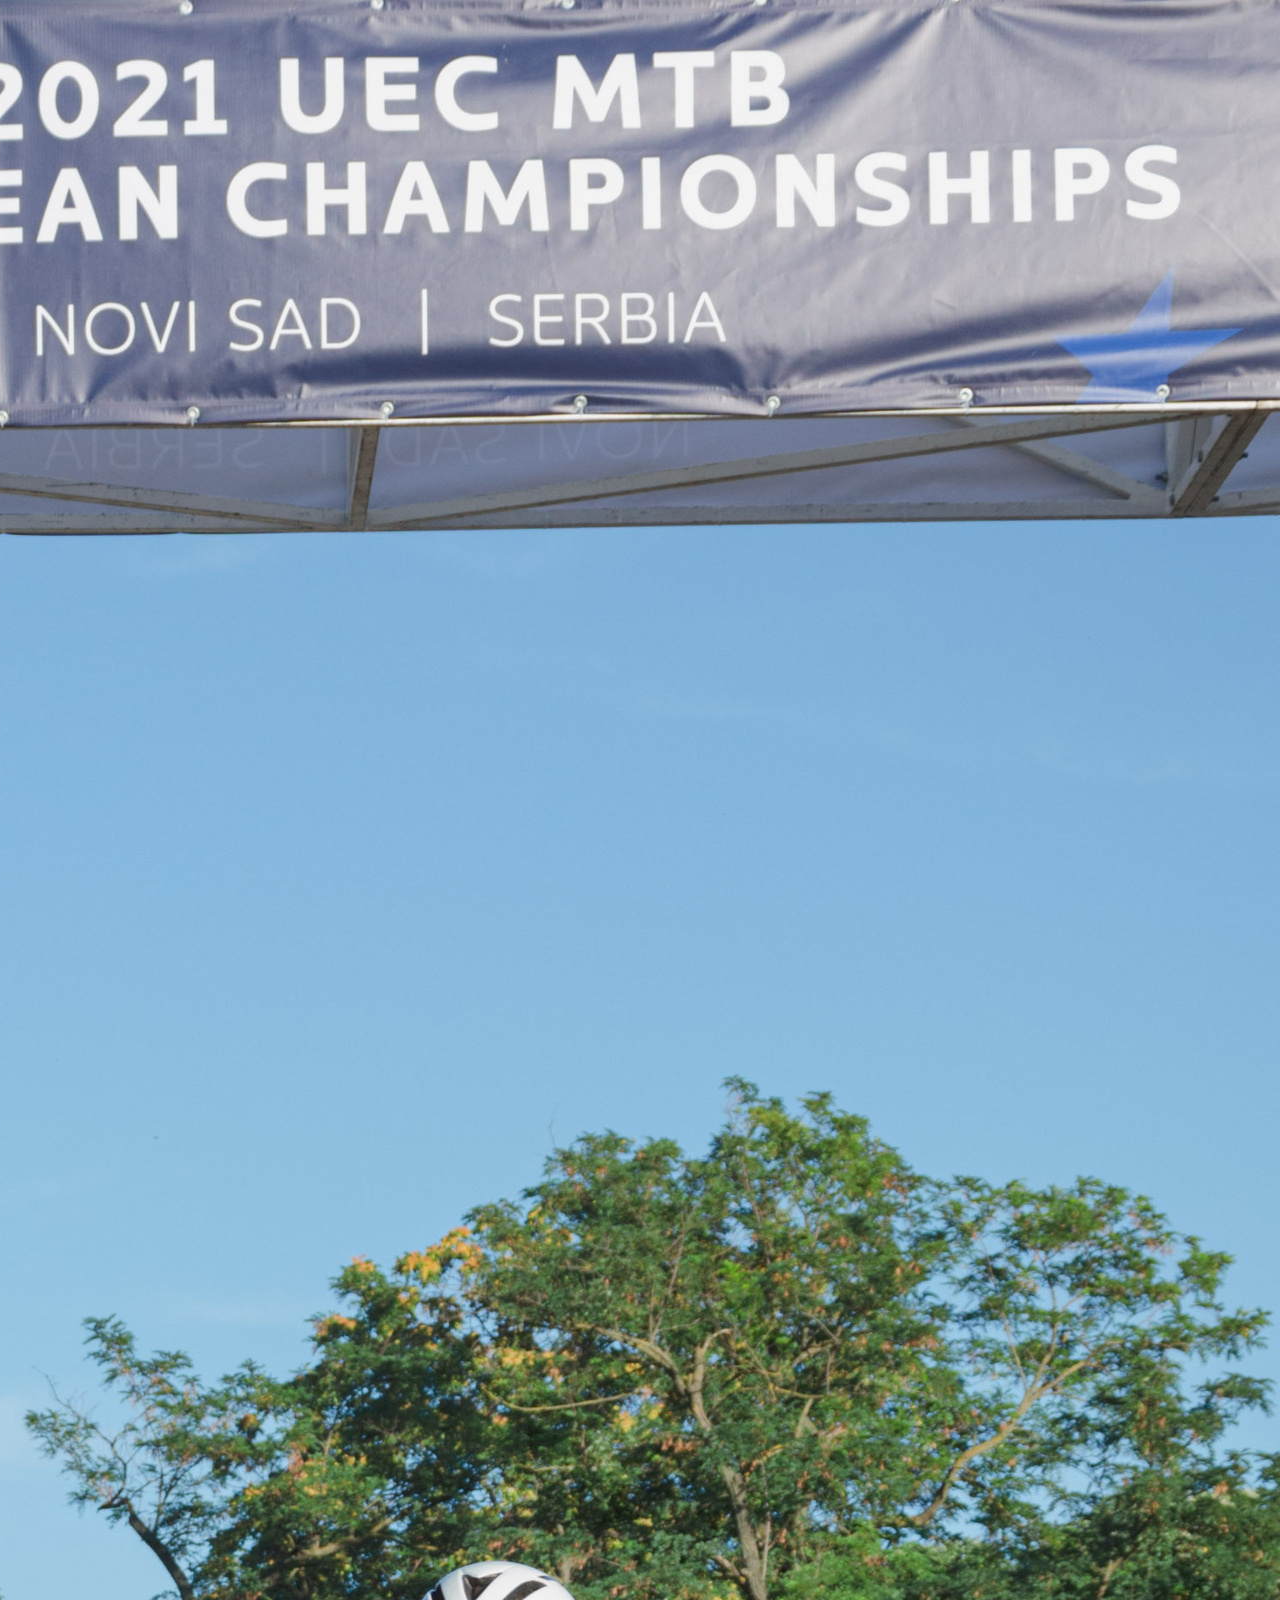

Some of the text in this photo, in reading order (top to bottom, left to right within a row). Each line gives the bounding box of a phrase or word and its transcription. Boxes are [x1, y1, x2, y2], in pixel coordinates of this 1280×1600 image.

[280, 54, 498, 133] UEC
[553, 49, 791, 130] MTB
[227, 145, 1181, 240] CHAMPIONSHIPS
[35, 300, 197, 357] NOVI
[229, 297, 362, 352] SAD
[488, 290, 728, 348] SERBIA
